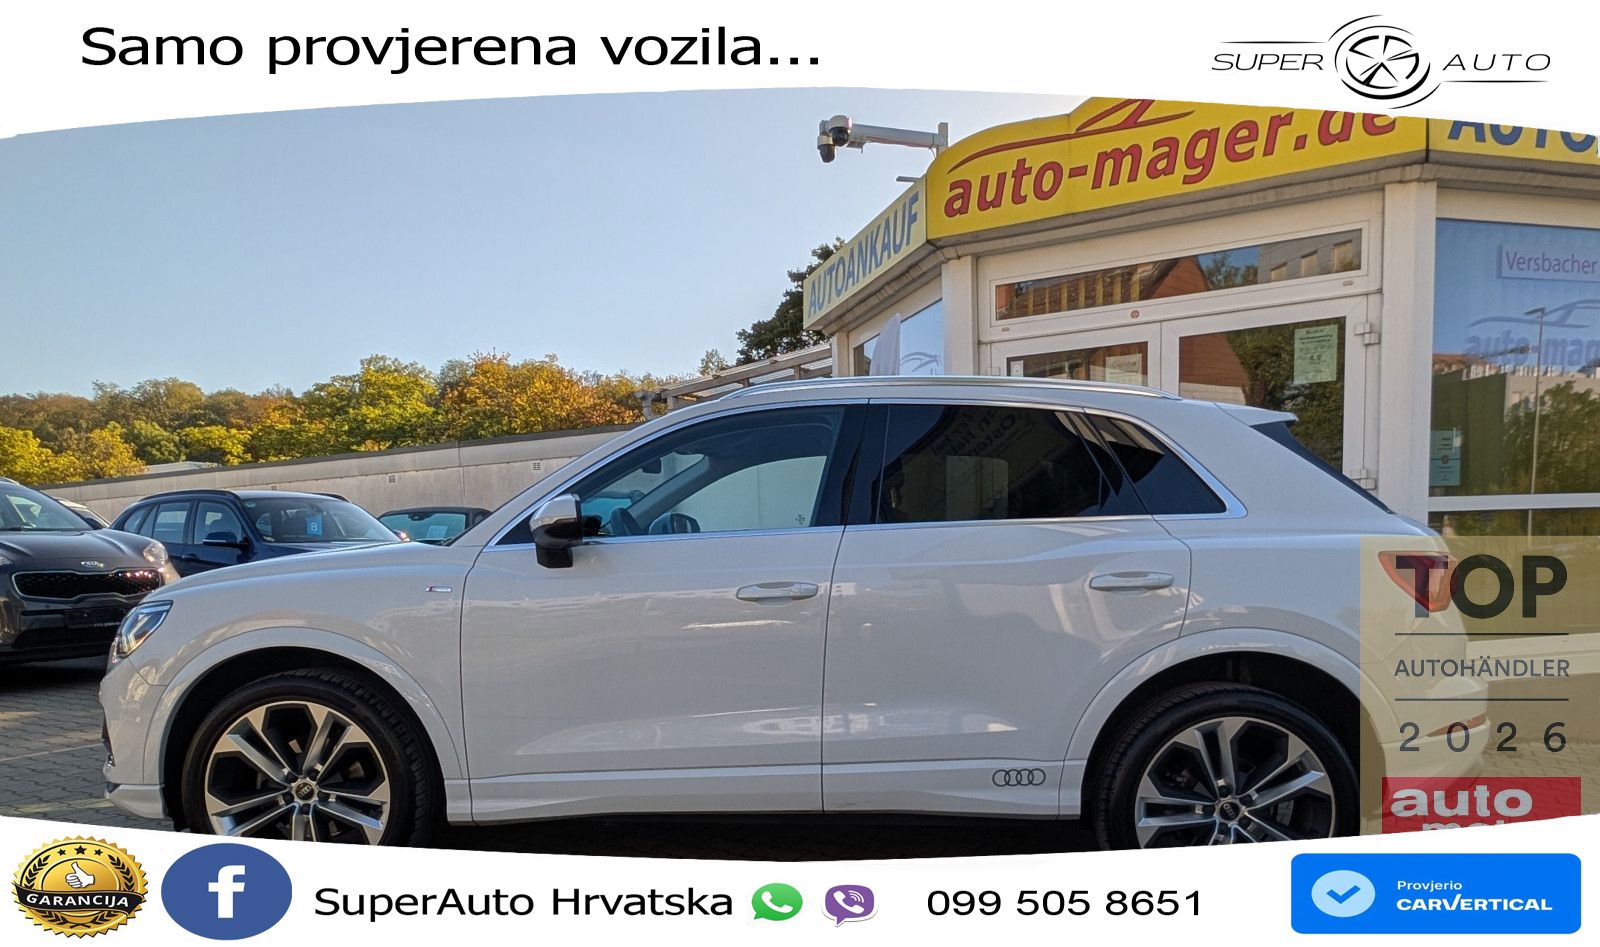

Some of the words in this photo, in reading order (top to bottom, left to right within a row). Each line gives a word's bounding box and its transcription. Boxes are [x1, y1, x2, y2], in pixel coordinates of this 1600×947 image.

[943, 109, 1397, 218] auto-mager.de
[807, 190, 920, 320] AUTOANKAUF
[1505, 250, 1598, 275] Versbacher
